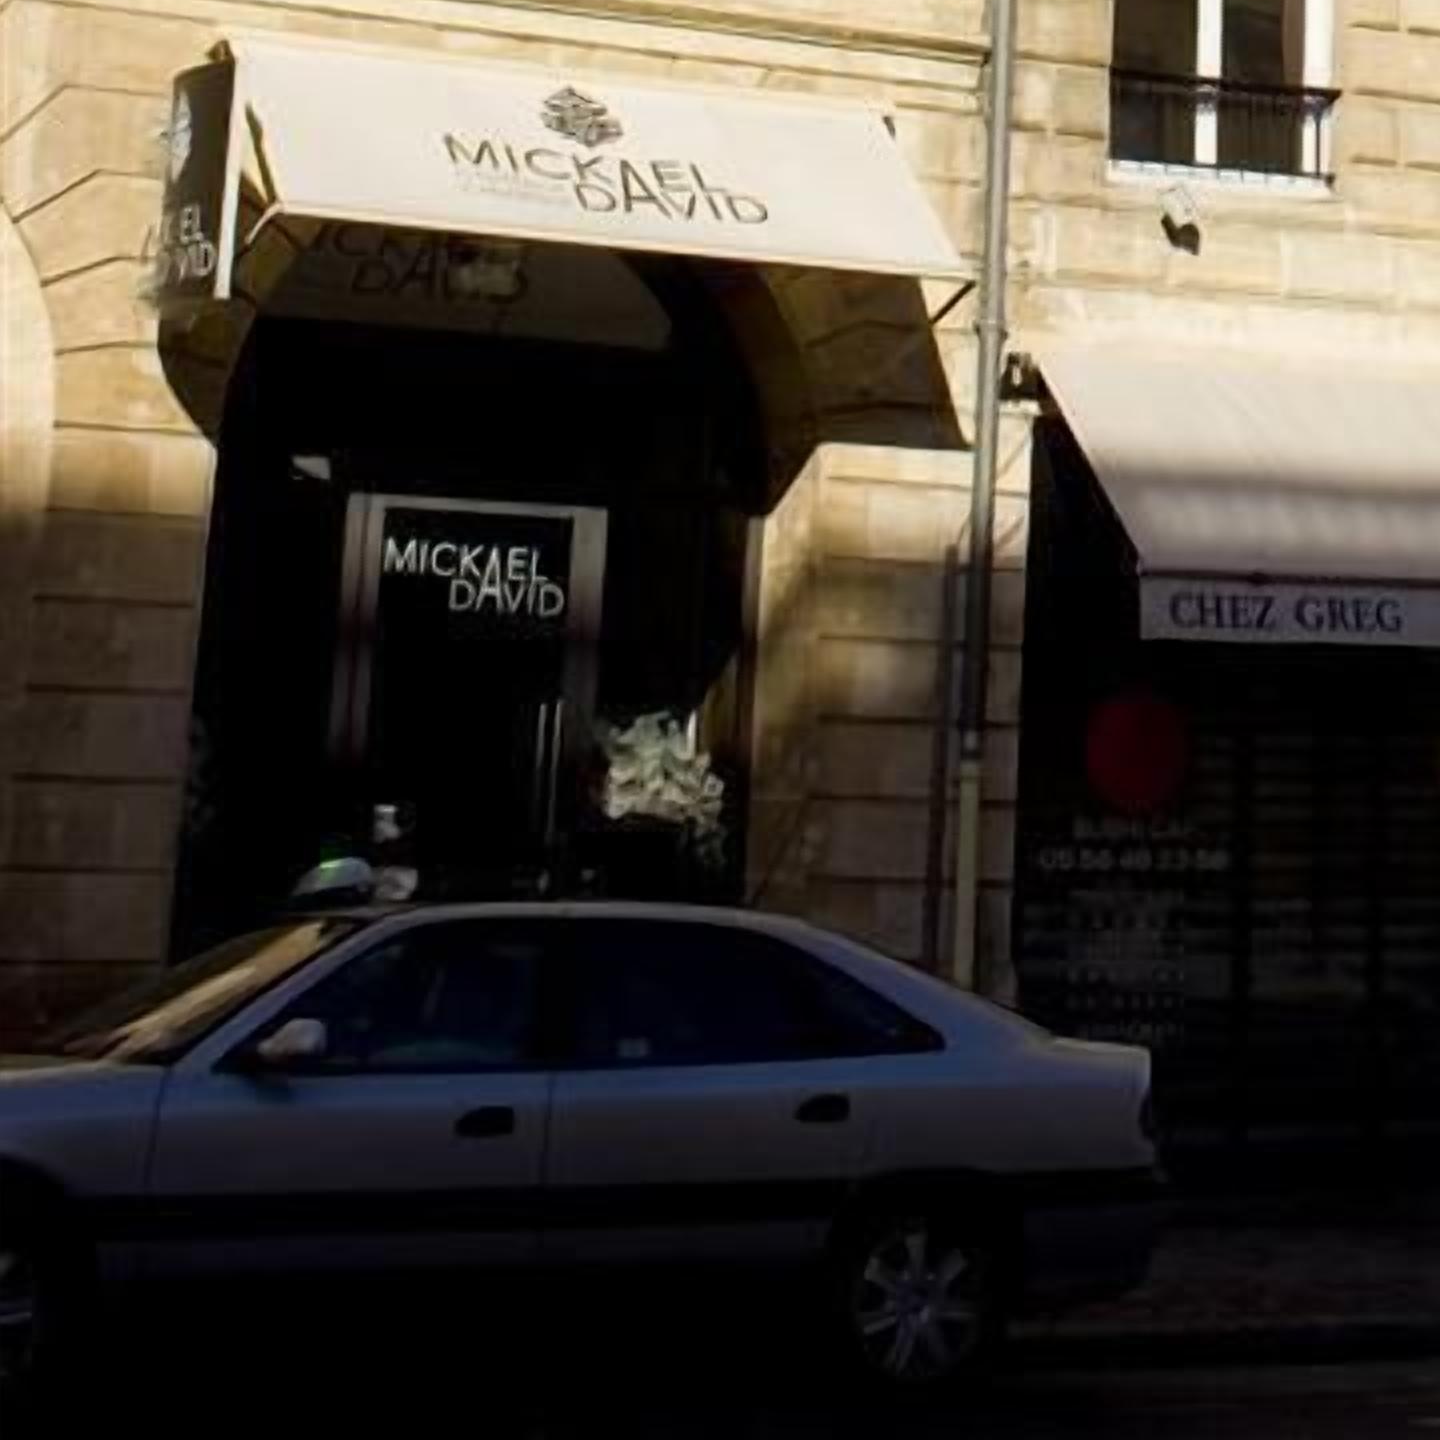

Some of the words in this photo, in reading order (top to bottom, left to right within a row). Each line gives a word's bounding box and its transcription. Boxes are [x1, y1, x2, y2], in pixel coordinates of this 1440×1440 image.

[443, 133, 728, 206] MICKAEL
[574, 170, 768, 225] DAVID
[383, 535, 549, 590] MICKAEL
[448, 568, 566, 620] DAVID
[1169, 593, 1276, 630] CHEZ
[1295, 596, 1402, 633] GREG
